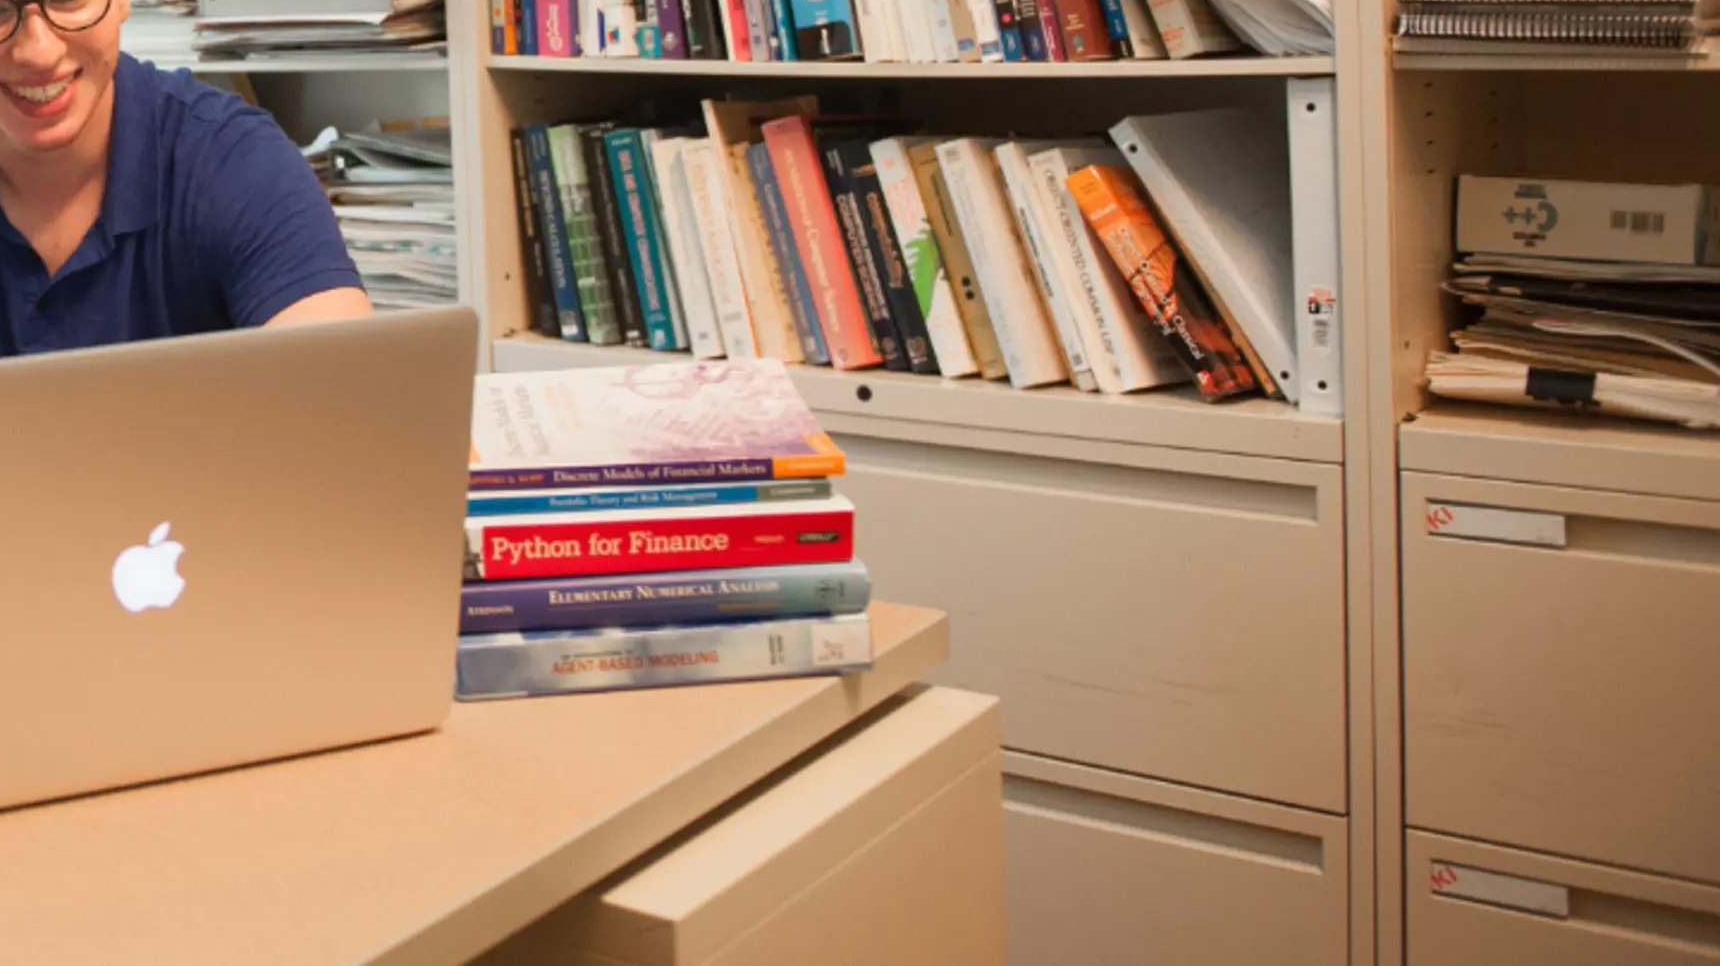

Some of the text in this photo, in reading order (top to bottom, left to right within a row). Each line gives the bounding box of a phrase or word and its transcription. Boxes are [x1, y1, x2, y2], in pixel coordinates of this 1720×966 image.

[552, 462, 767, 482] Discrete Models of Financial Markets
[1426, 505, 1454, 531] KI
[491, 530, 729, 566] Python for Finance
[548, 580, 779, 605] ELEMENTARY NUMERICAL ANALYSIS
[647, 649, 719, 669] MODELING
[1430, 865, 1458, 890] KI
